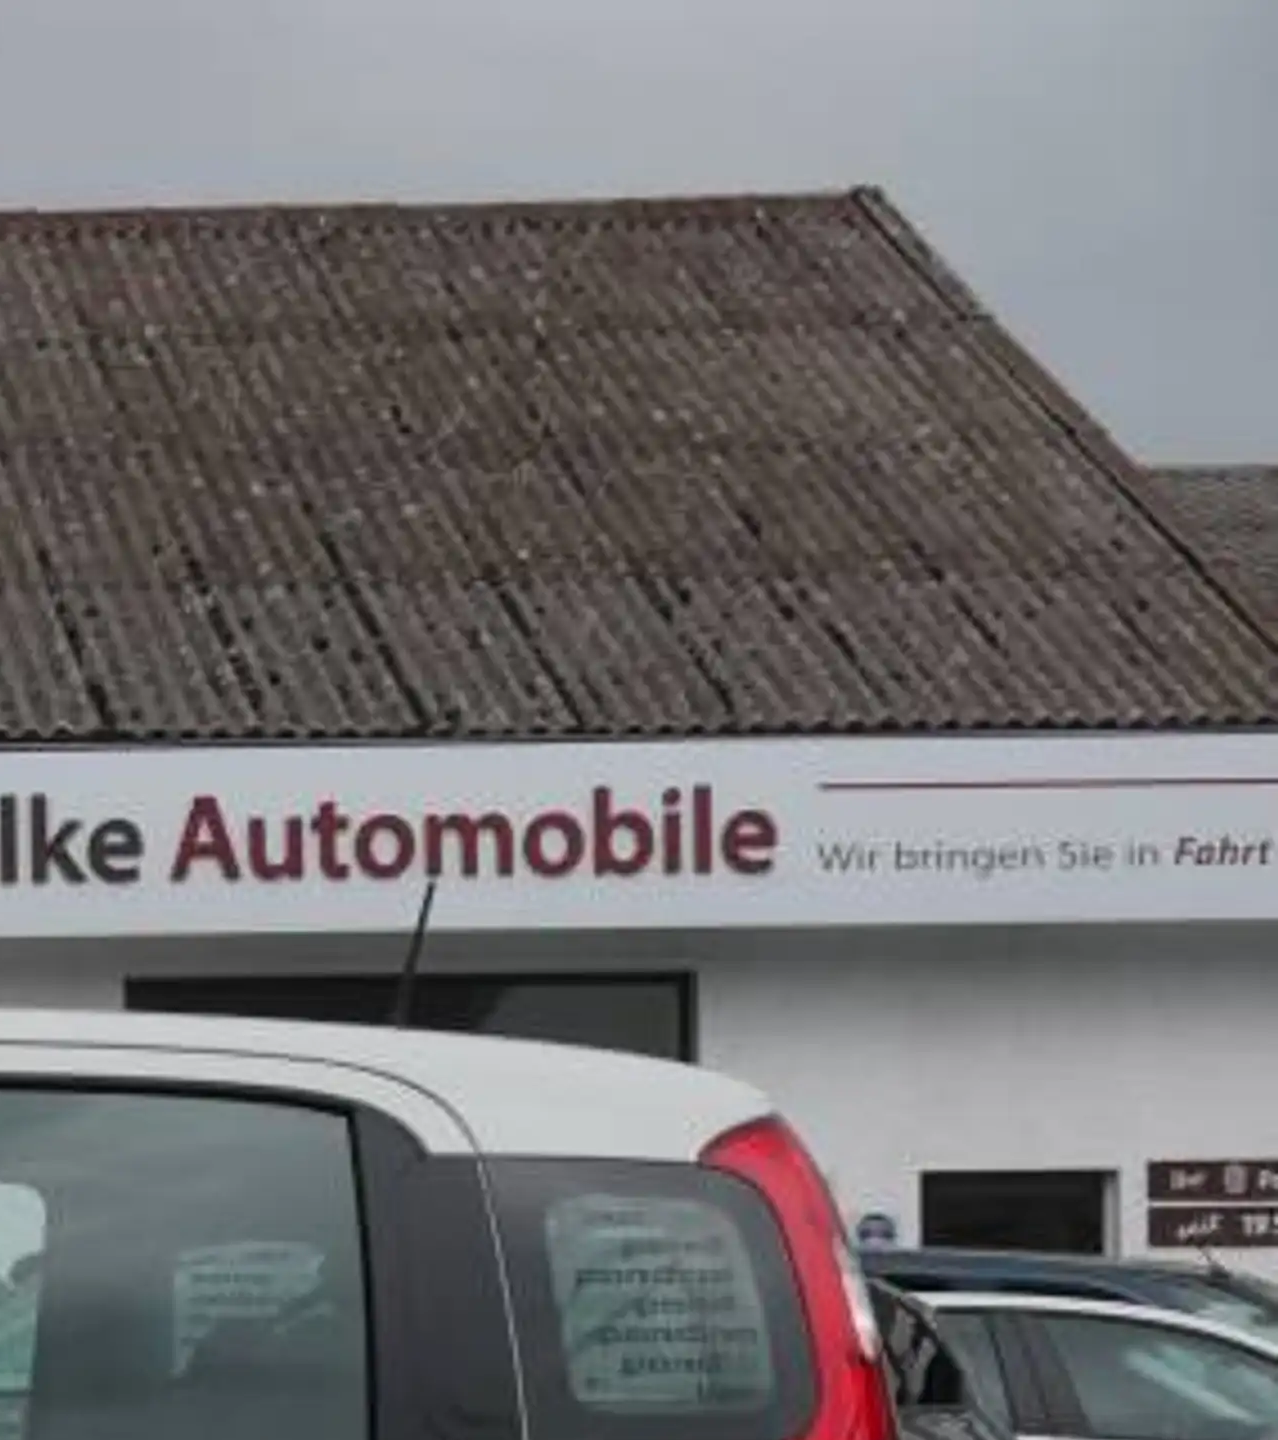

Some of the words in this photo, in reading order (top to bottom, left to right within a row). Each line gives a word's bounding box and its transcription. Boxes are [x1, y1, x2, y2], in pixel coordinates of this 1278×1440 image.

[169, 785, 778, 882] Automobile
[818, 841, 878, 873] Wir
[894, 840, 1046, 880] bringen
[1057, 840, 1115, 871] Sie
[1127, 836, 1160, 867] in
[1173, 835, 1272, 867] Fahrt
